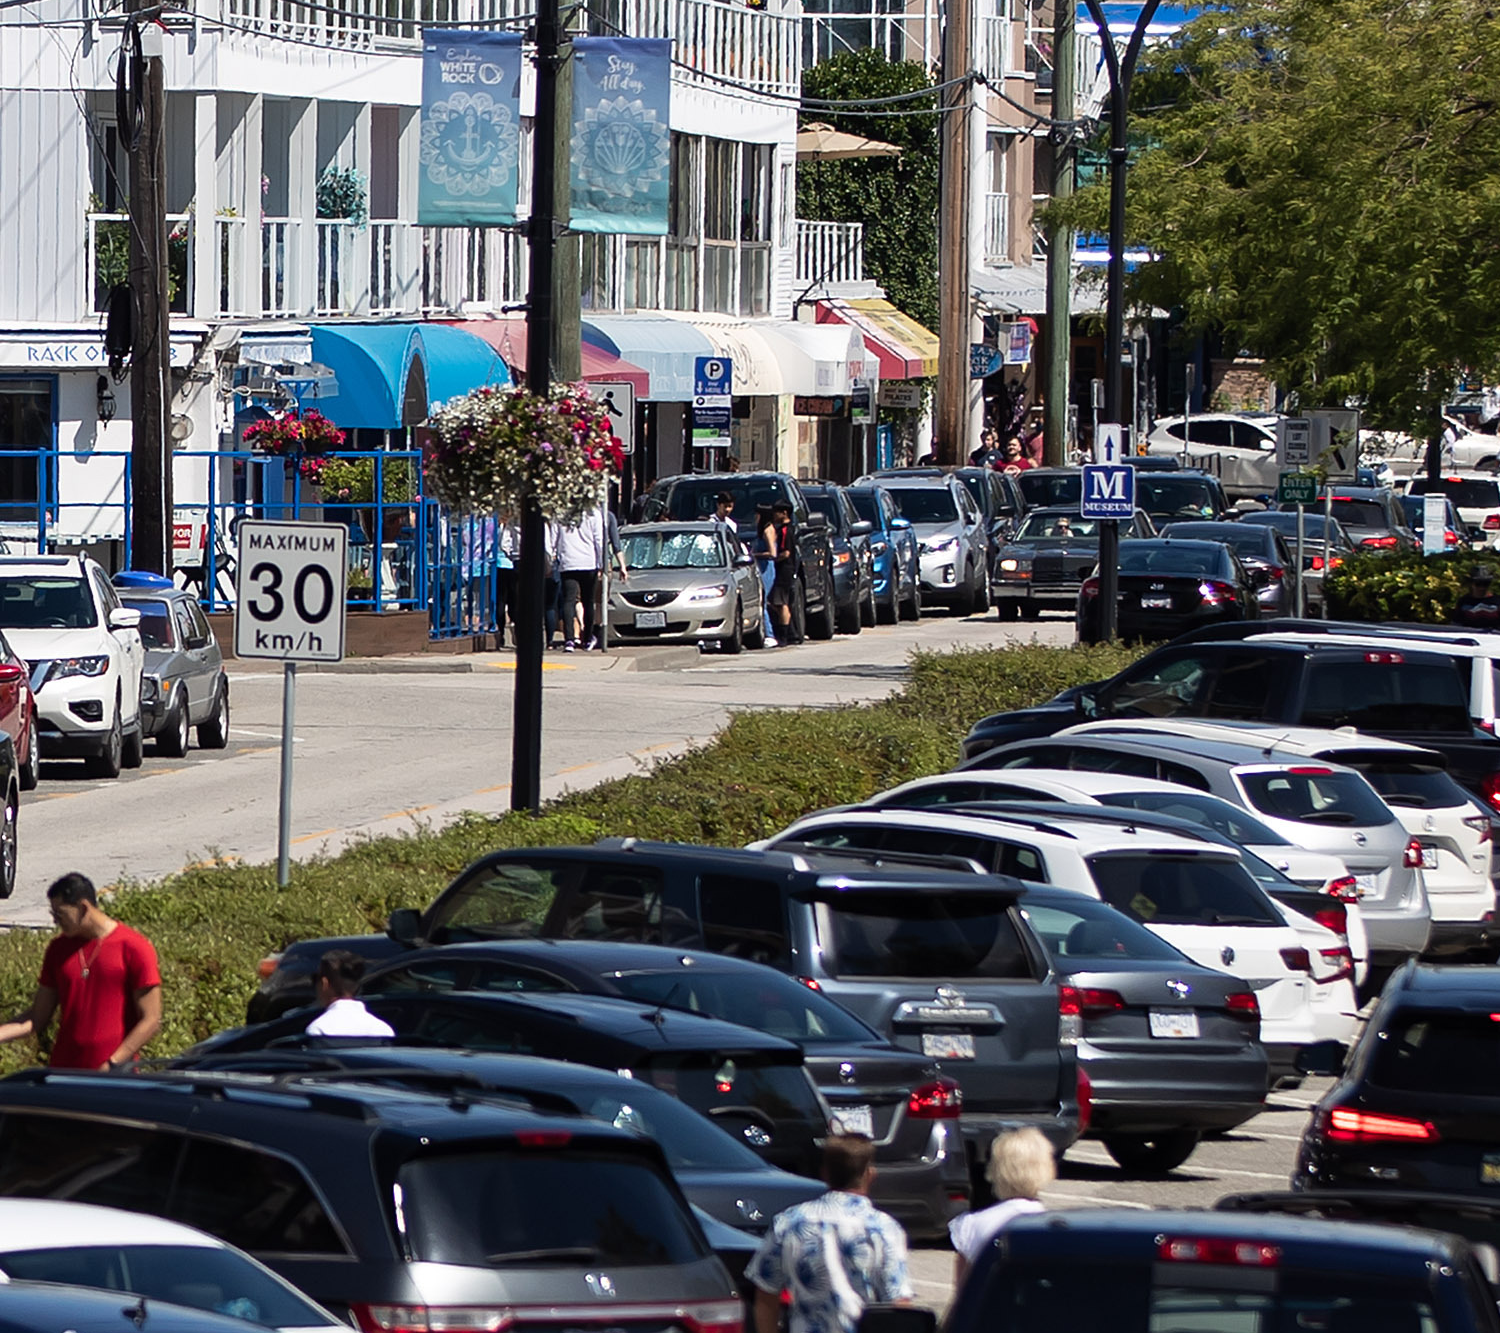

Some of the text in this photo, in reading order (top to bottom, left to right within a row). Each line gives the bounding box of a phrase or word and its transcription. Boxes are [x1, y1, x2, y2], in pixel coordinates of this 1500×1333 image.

[441, 72, 475, 83] ROCK
[599, 76, 619, 91] All
[27, 345, 80, 362] RACK
[710, 362, 720, 377] P
[1090, 471, 1127, 500] M
[1282, 478, 1312, 488] ENTER
[1284, 489, 1309, 499] ONLY
[1084, 502, 1131, 512] MUSEUM
[249, 534, 335, 552] MAXIMUM
[247, 561, 334, 624] 30
[255, 629, 322, 652] km/h
